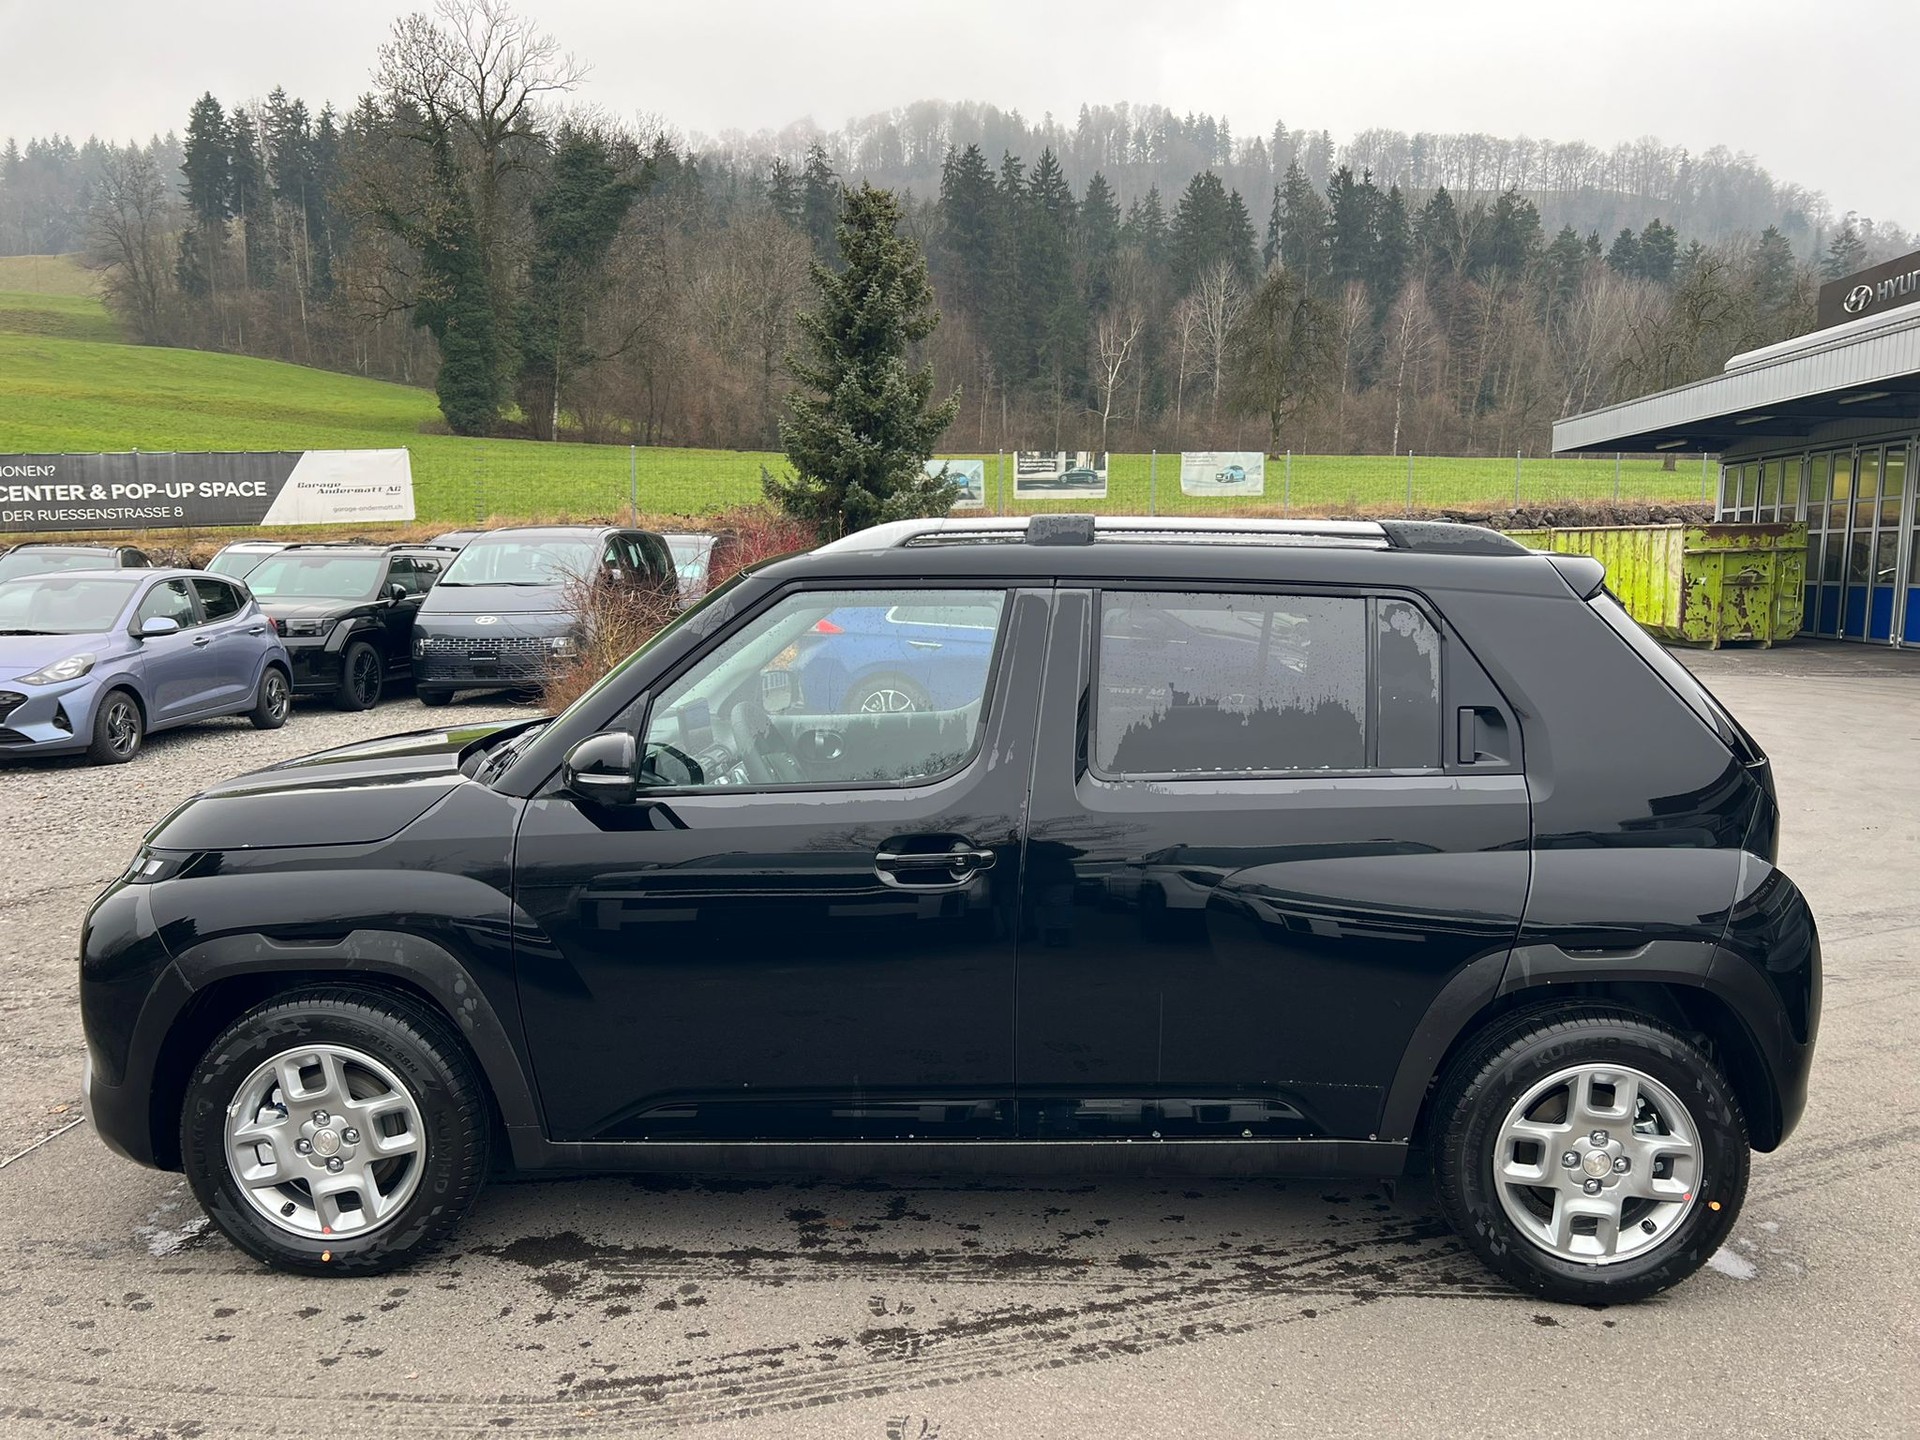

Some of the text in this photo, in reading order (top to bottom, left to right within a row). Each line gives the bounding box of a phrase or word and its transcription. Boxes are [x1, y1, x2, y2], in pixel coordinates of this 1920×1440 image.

[89, 484, 107, 500] &
[111, 482, 195, 500] POP-UP
[199, 481, 268, 498] SPACE
[297, 481, 342, 489] Garage
[317, 486, 382, 495] Andermatt
[2, 506, 184, 522] DER RUESSENSTRASSE 8
[395, 1050, 419, 1073] 88H
[434, 1111, 453, 1194] KUMHO
